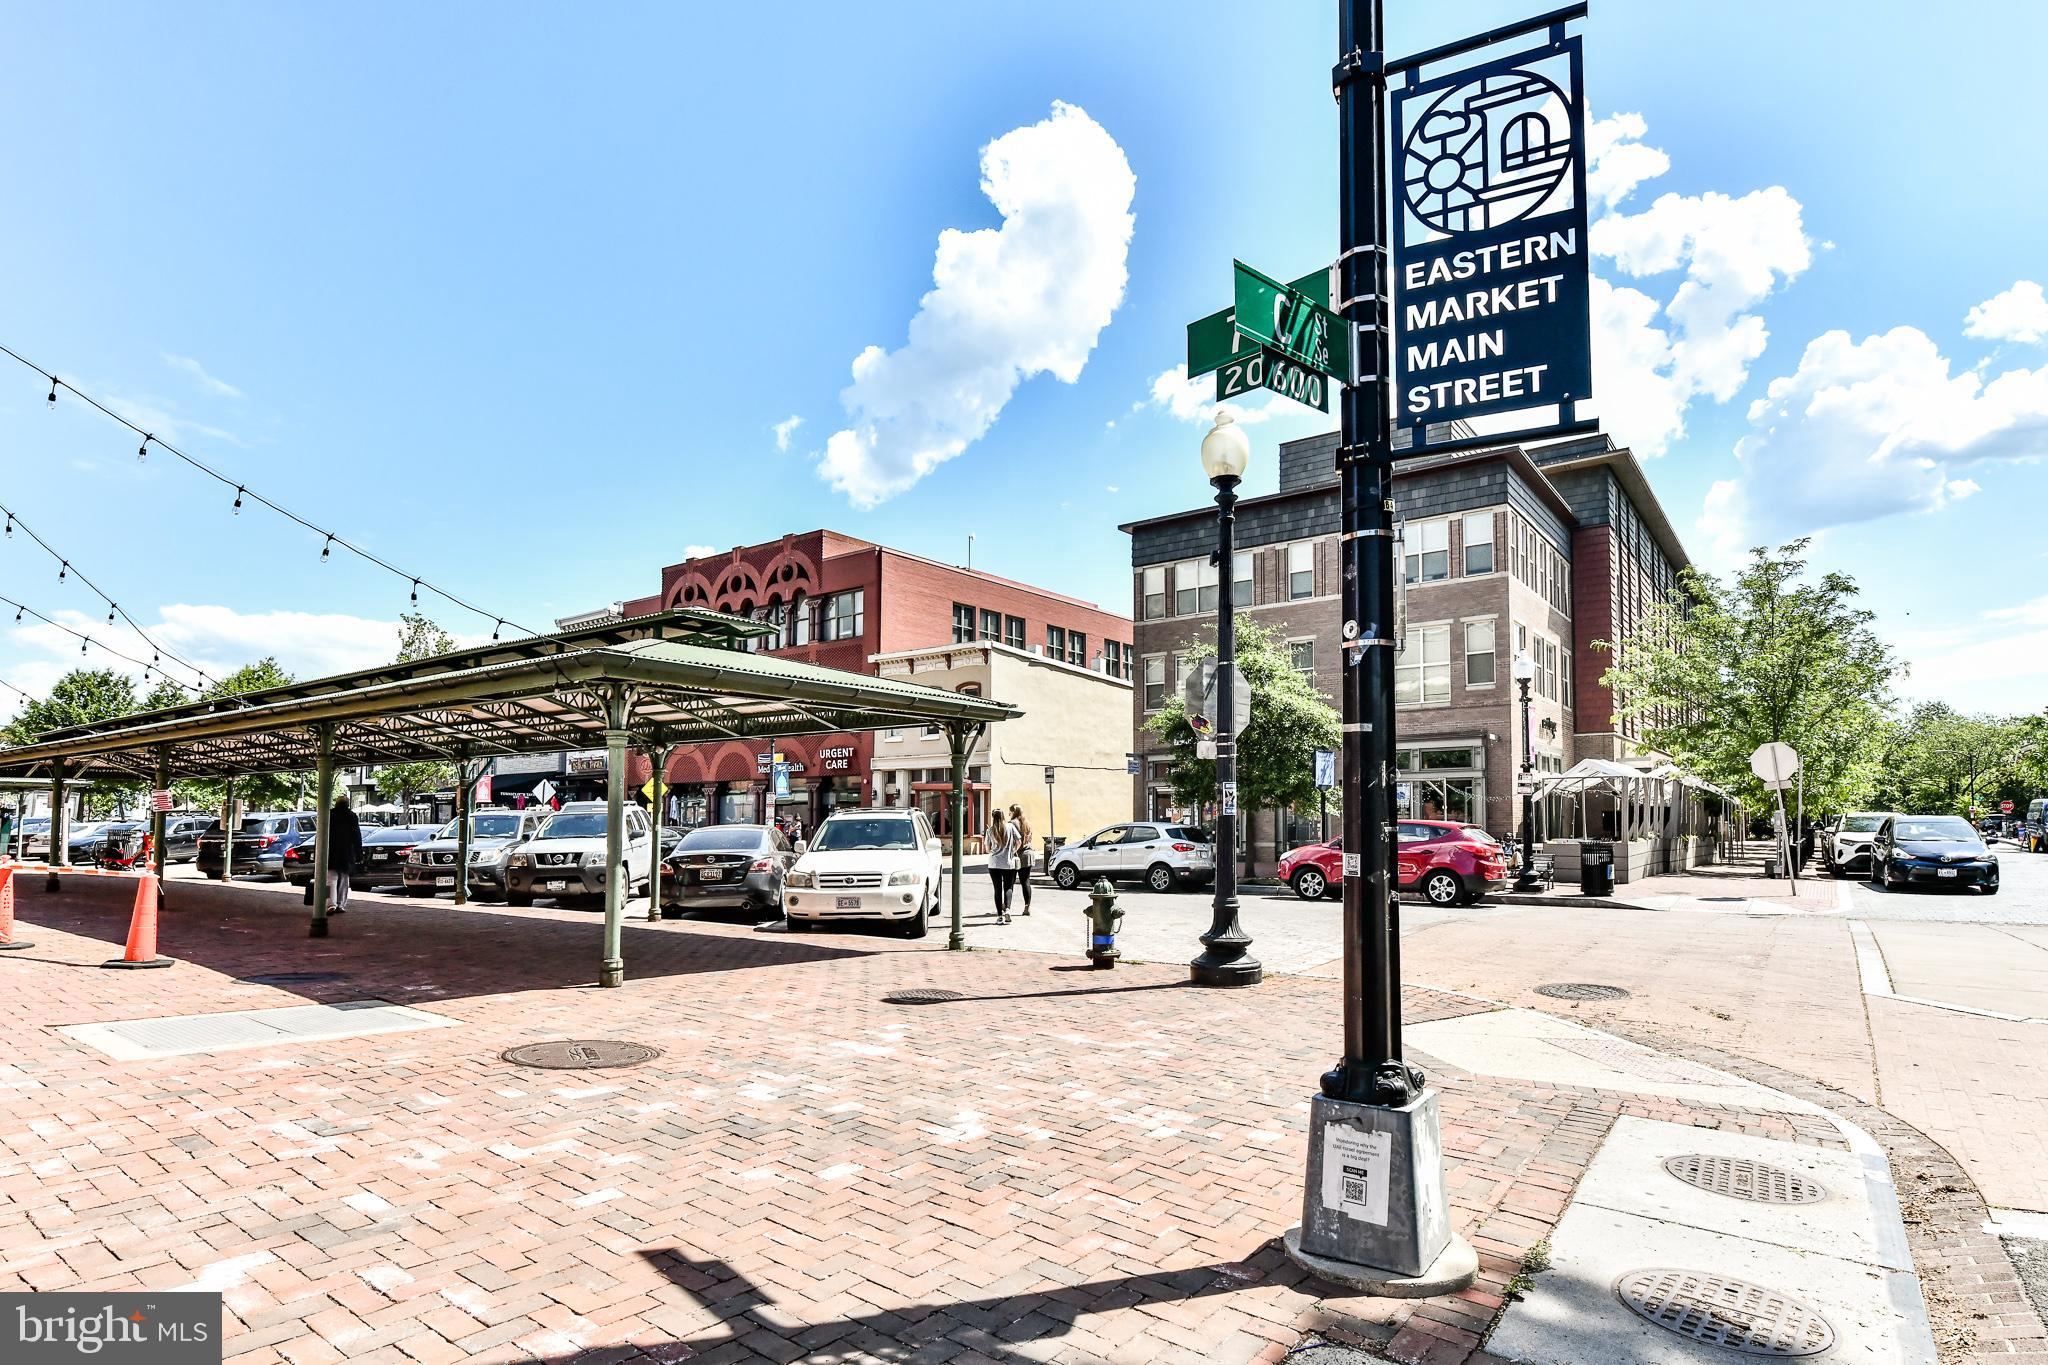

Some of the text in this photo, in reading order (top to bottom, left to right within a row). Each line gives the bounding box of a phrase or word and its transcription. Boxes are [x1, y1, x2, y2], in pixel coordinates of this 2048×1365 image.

[1405, 227, 1577, 290] EASTERN
[1406, 274, 1564, 332] MARKET
[1407, 329, 1504, 373] MAIN
[1272, 359, 1322, 407] 600
[1408, 364, 1548, 413] STREET
[819, 747, 855, 759] URGENT
[825, 759, 849, 770] CARE
